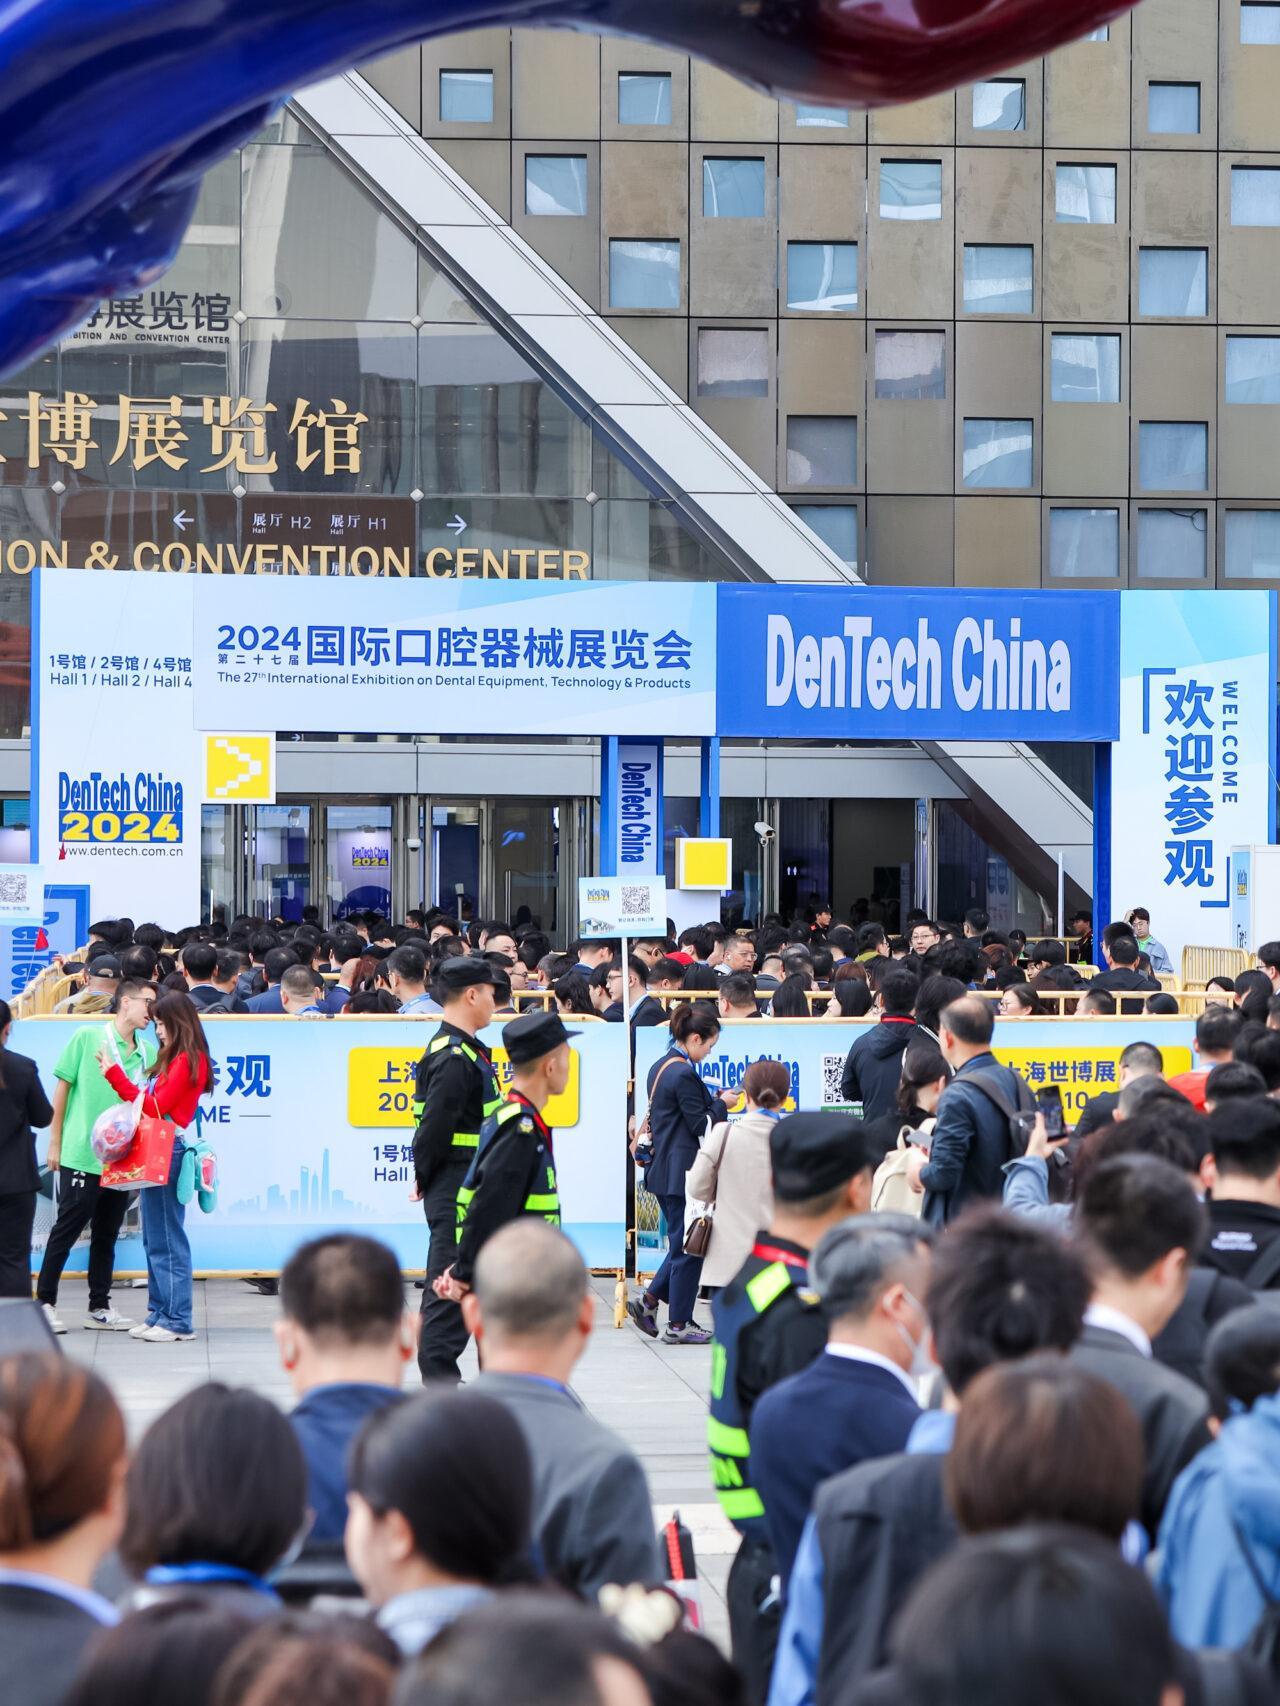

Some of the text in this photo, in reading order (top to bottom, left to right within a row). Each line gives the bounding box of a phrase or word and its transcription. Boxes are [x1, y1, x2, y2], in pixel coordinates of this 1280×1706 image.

[87, 290, 232, 332] 展览馆
[70, 331, 230, 344] BITION AND CONVENTION CENTER
[0, 390, 370, 476] 博展览馆
[253, 512, 387, 530] 展厅 H2 展厅 H1
[0, 539, 68, 574] ON
[84, 541, 119, 576] &
[134, 541, 410, 577] CONVENTION
[426, 546, 591, 580] CENTER
[50, 654, 86, 669] 1号馆
[101, 655, 139, 671] 2号馆
[153, 657, 192, 672] 4号馆
[217, 653, 300, 665] 第二十七届
[766, 614, 1071, 713] DenTech China
[50, 673, 78, 685] Hall
[82, 673, 87, 685] 1
[101, 674, 128, 686] Hall
[132, 674, 141, 686] 2
[154, 675, 180, 688] Hall
[184, 676, 192, 687] 4
[217, 672, 241, 683] The
[267, 673, 349, 684] International
[352, 674, 414, 685] Exhibition
[417, 677, 433, 685] on
[435, 675, 475, 686] Dental
[478, 676, 548, 688] Equipment,
[551, 676, 622, 690] Technology
[624, 678, 632, 688] &
[635, 678, 691, 689] Products
[1221, 680, 1238, 804] WELCOME
[58, 771, 183, 812] DenTech China
[1164, 679, 1215, 888] 欢迎参观
[621, 762, 652, 863] DenTech China
[61, 812, 180, 842] 2024
[59, 845, 183, 857] www.dentech.com.cn
[352, 857, 388, 866] 2024
[374, 1167, 408, 1182] Hall
